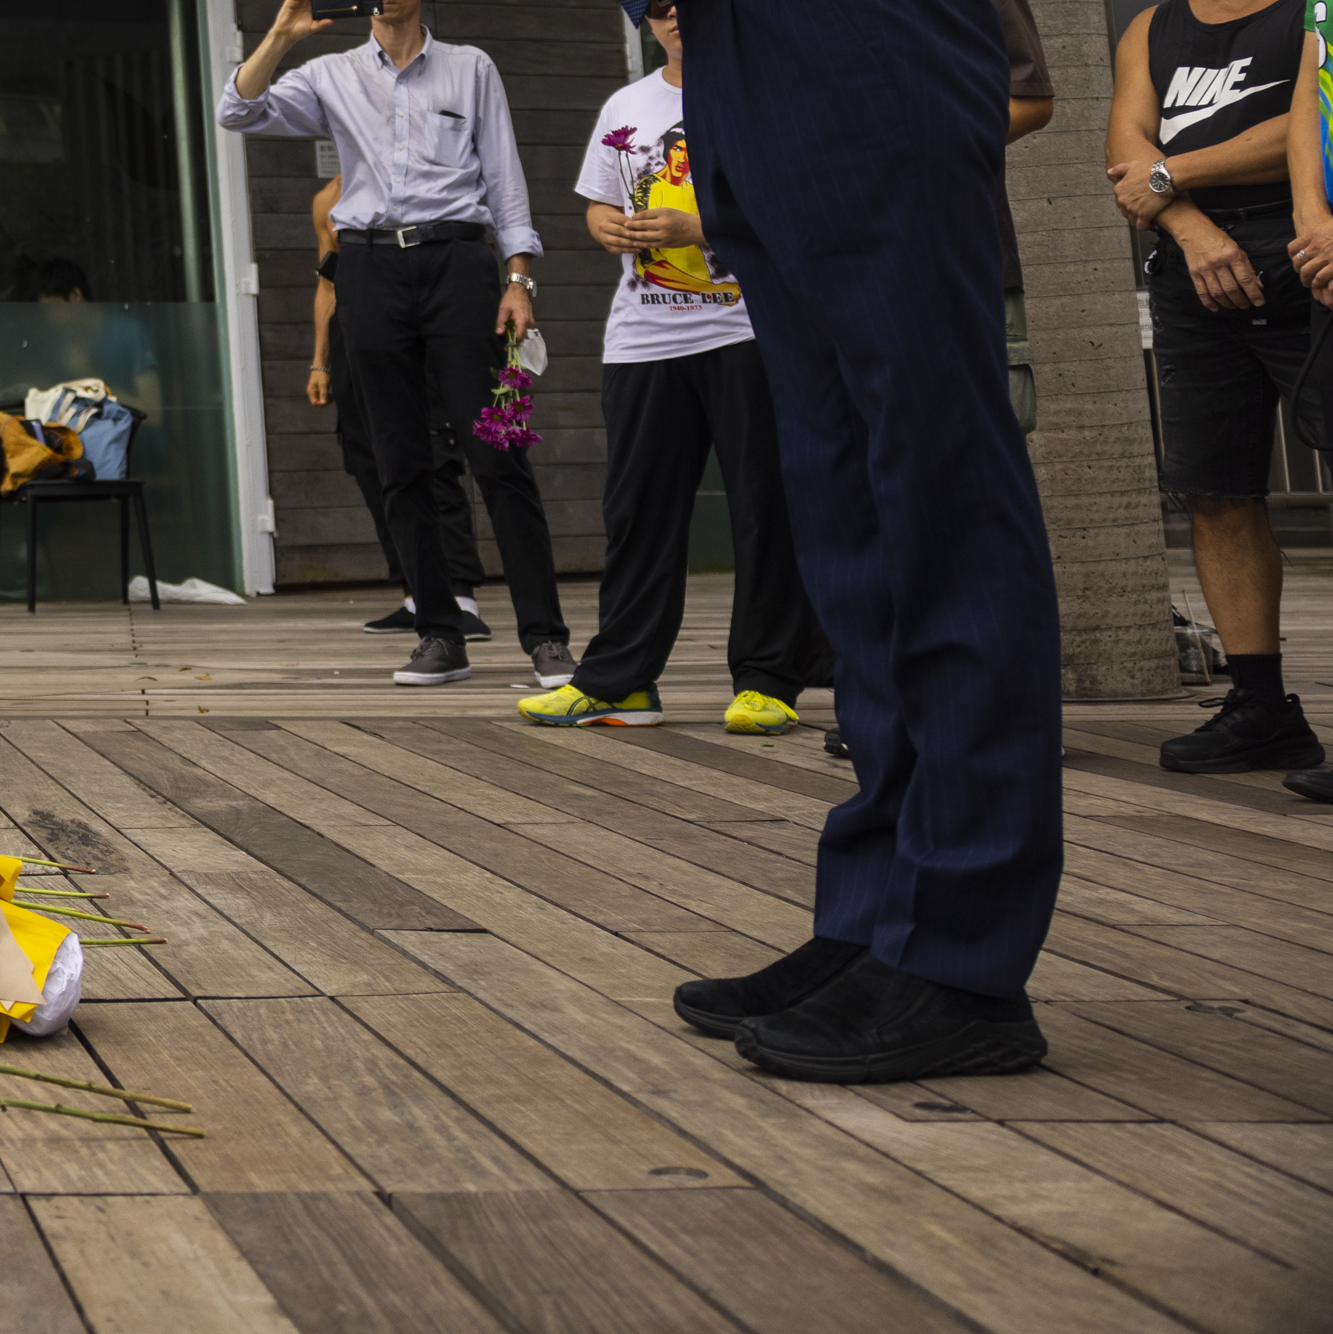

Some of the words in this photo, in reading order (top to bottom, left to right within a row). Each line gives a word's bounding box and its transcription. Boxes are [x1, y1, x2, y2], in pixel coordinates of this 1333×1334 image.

[1163, 56, 1253, 108] NIKE
[640, 293, 694, 305] BRUCE
[700, 292, 735, 304] LEE
